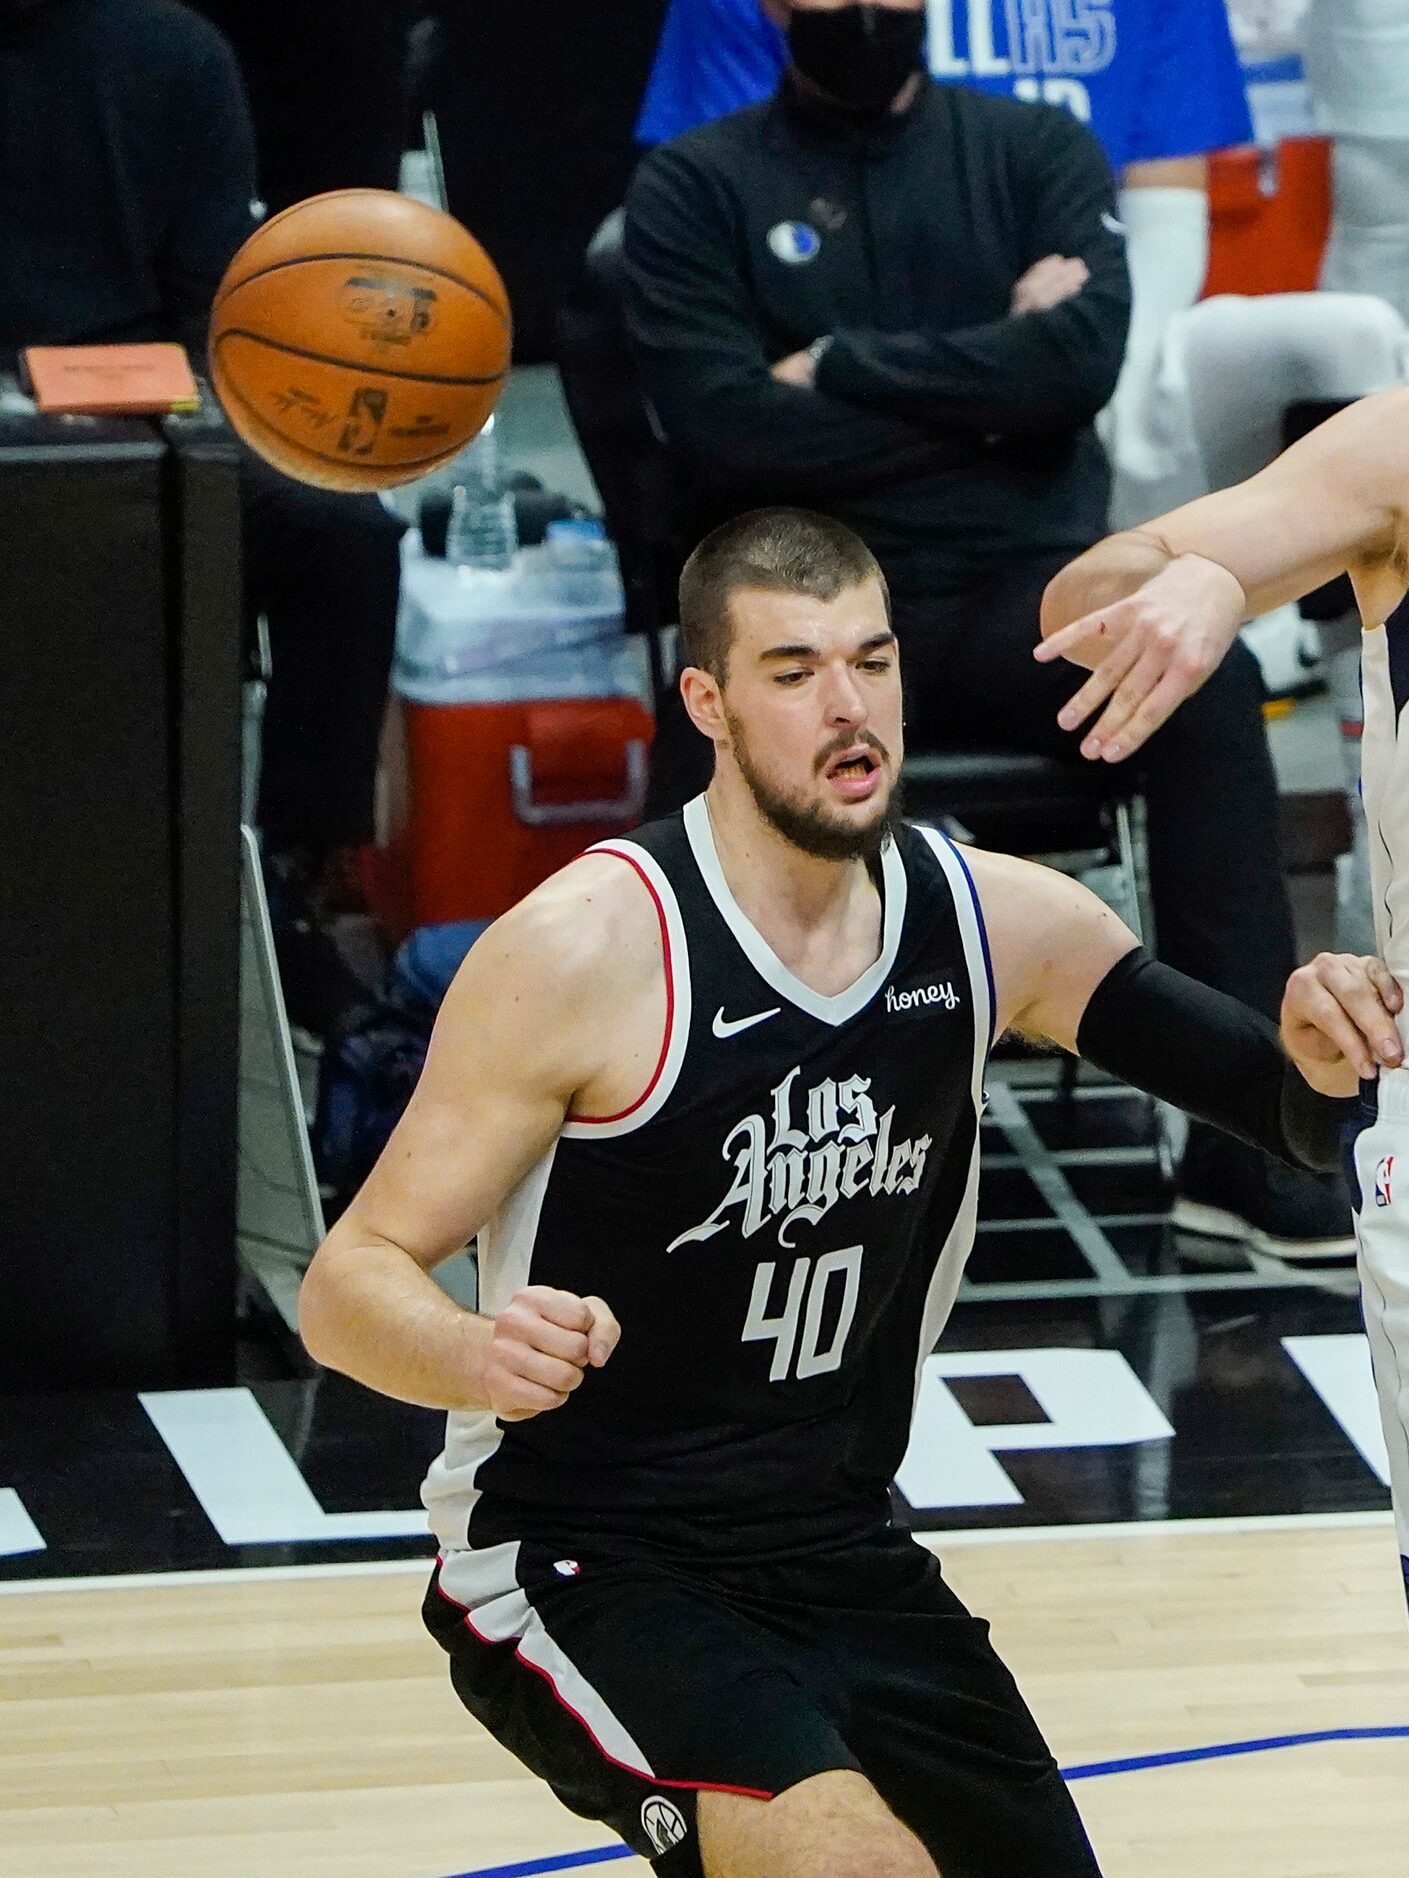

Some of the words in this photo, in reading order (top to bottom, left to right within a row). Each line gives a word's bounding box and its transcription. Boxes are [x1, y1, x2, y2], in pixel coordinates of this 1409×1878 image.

[884, 980, 960, 1013] honey
[766, 1065, 878, 1157] Los
[666, 1104, 933, 1254] Angeles
[741, 1244, 864, 1382] 40
